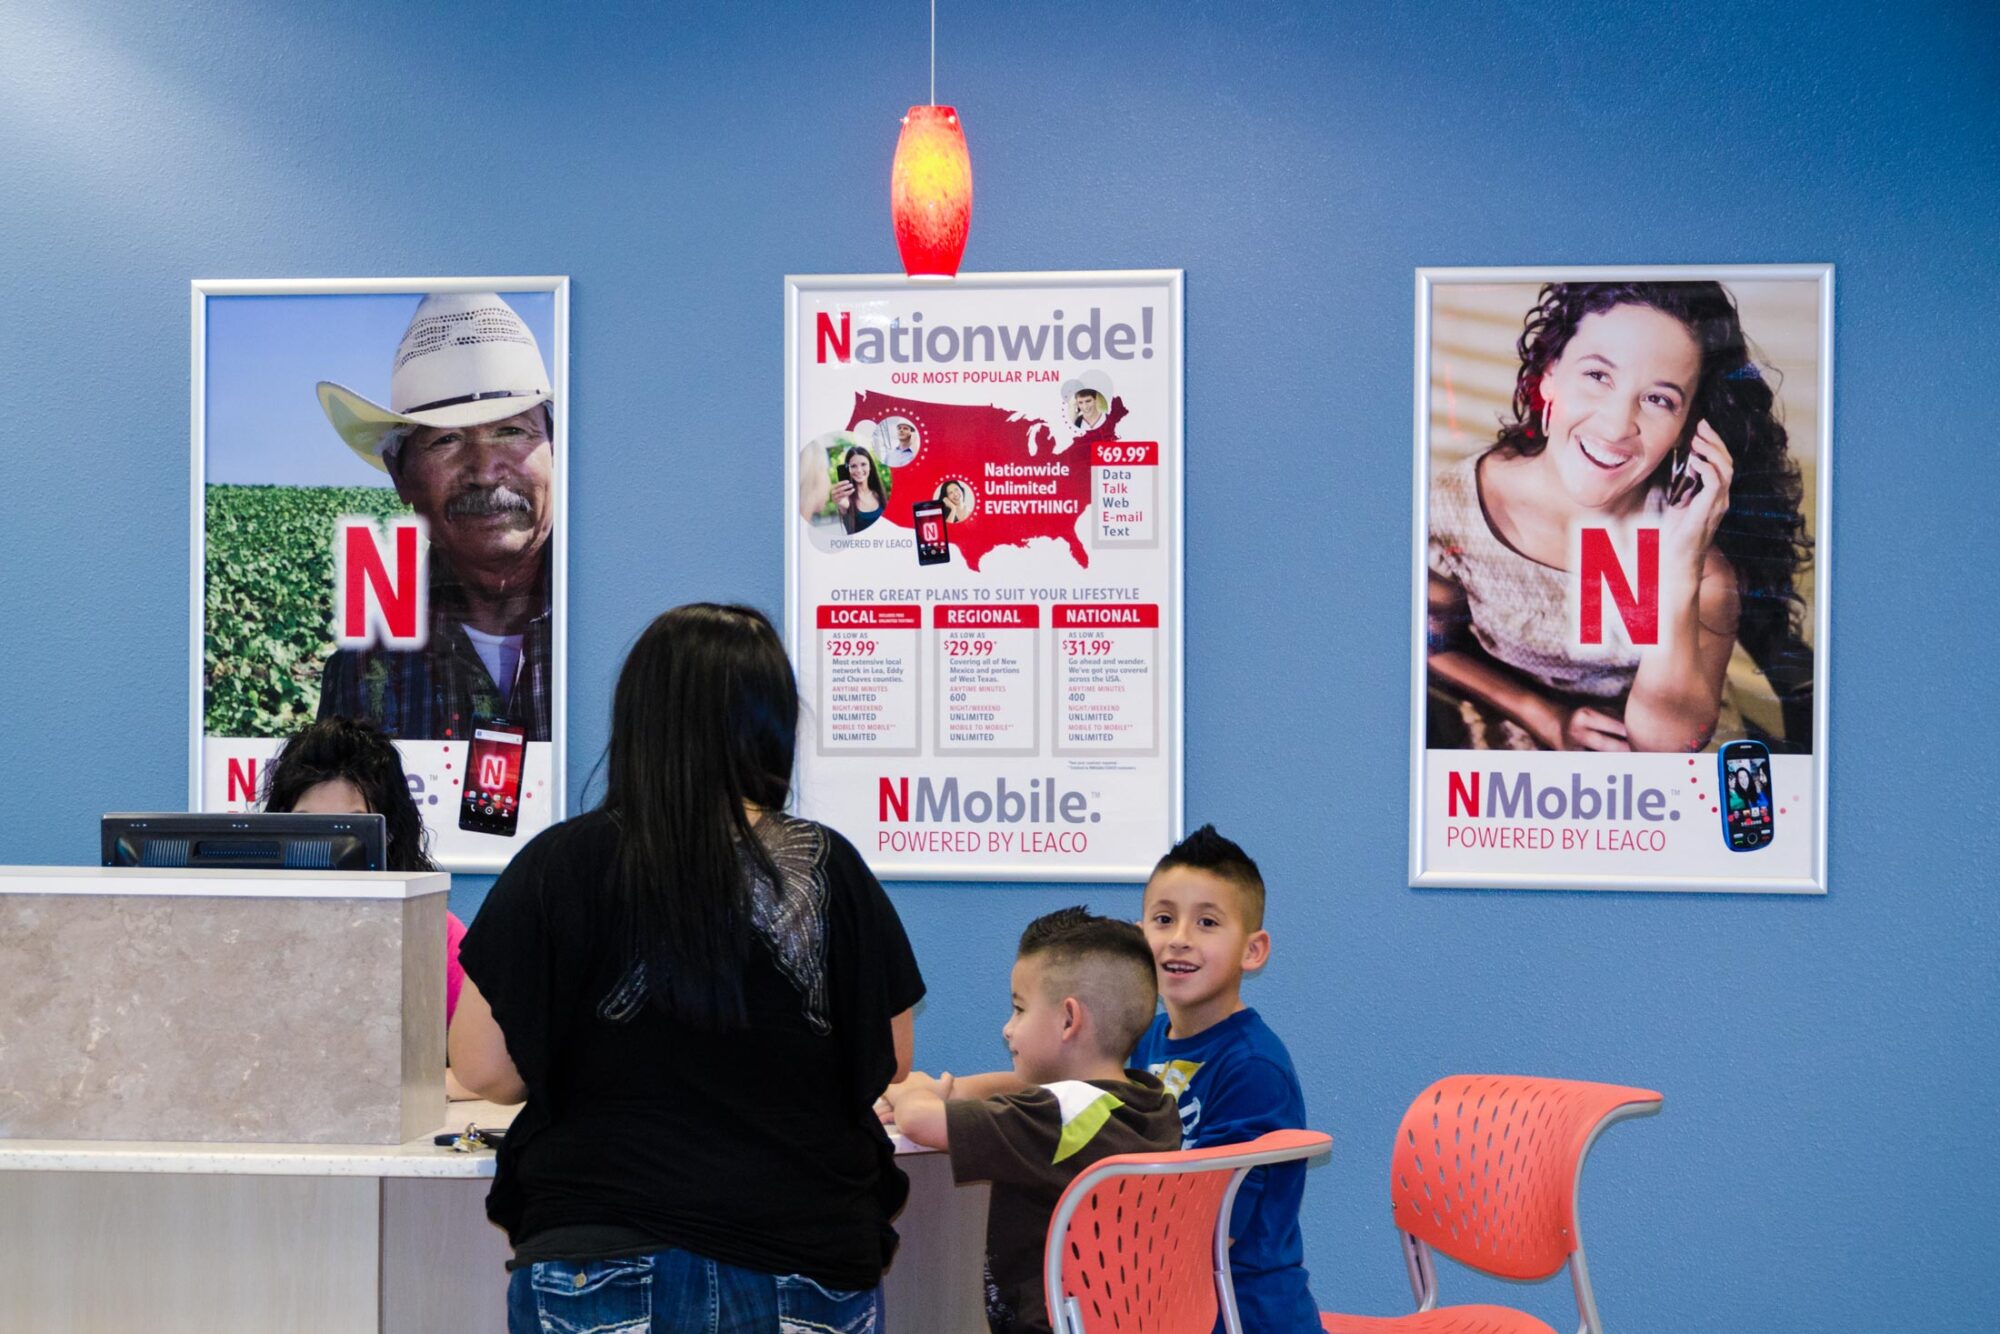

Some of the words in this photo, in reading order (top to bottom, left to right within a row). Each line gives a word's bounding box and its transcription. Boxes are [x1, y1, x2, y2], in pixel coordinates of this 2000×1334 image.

[816, 307, 1154, 364] Nationwide!
[891, 371, 919, 384] OUR
[922, 371, 958, 384] MOST
[963, 371, 1023, 384] POPULAR
[1026, 371, 1060, 384] PLAN
[984, 462, 1070, 477] Nationwide
[1102, 468, 1132, 481] Data
[984, 480, 1057, 495] Unlimited
[1102, 482, 1128, 494] Talk
[984, 499, 1079, 515] EVERYTHING!
[1102, 497, 1130, 509] Web
[1102, 511, 1143, 523] E-mail
[1102, 525, 1130, 537] Text
[830, 538, 872, 549] POWERED
[873, 538, 884, 549] BY
[886, 538, 913, 549] LEACO
[345, 526, 417, 638] N
[1580, 528, 1660, 645] N
[831, 588, 875, 602] OTHER
[879, 588, 921, 602] GREAT
[926, 588, 968, 602] PLANS
[973, 588, 991, 602] TO
[995, 588, 1025, 602] SUIT
[1030, 588, 1068, 602] YOUR
[1073, 588, 1140, 602] LIFESTYLE
[831, 609, 877, 624] LOCAL
[947, 609, 1022, 624] REGIONAL
[1066, 608, 1141, 623] NATIONAL
[832, 667, 861, 675] network
[863, 667, 870, 675] in
[871, 667, 885, 675] Lea,
[886, 667, 904, 675] Eddy
[832, 693, 877, 702] UNLIMITED
[949, 693, 967, 702] 600
[1068, 693, 1086, 702] 400
[832, 713, 877, 721] UNLIMITED
[949, 713, 995, 721] UNLIMITED
[1068, 713, 1114, 721] UNLIMITED
[832, 733, 877, 741] UNLIMITED
[949, 733, 995, 741] UNLIMITED
[1068, 733, 1114, 741] UNLIMITED
[878, 831, 981, 853] POWERED
[989, 831, 1013, 853] BY
[1021, 831, 1088, 853] LEACO
[1447, 827, 1554, 851] POWERED
[1562, 827, 1589, 851] BY
[1596, 827, 1666, 851] LEACO
